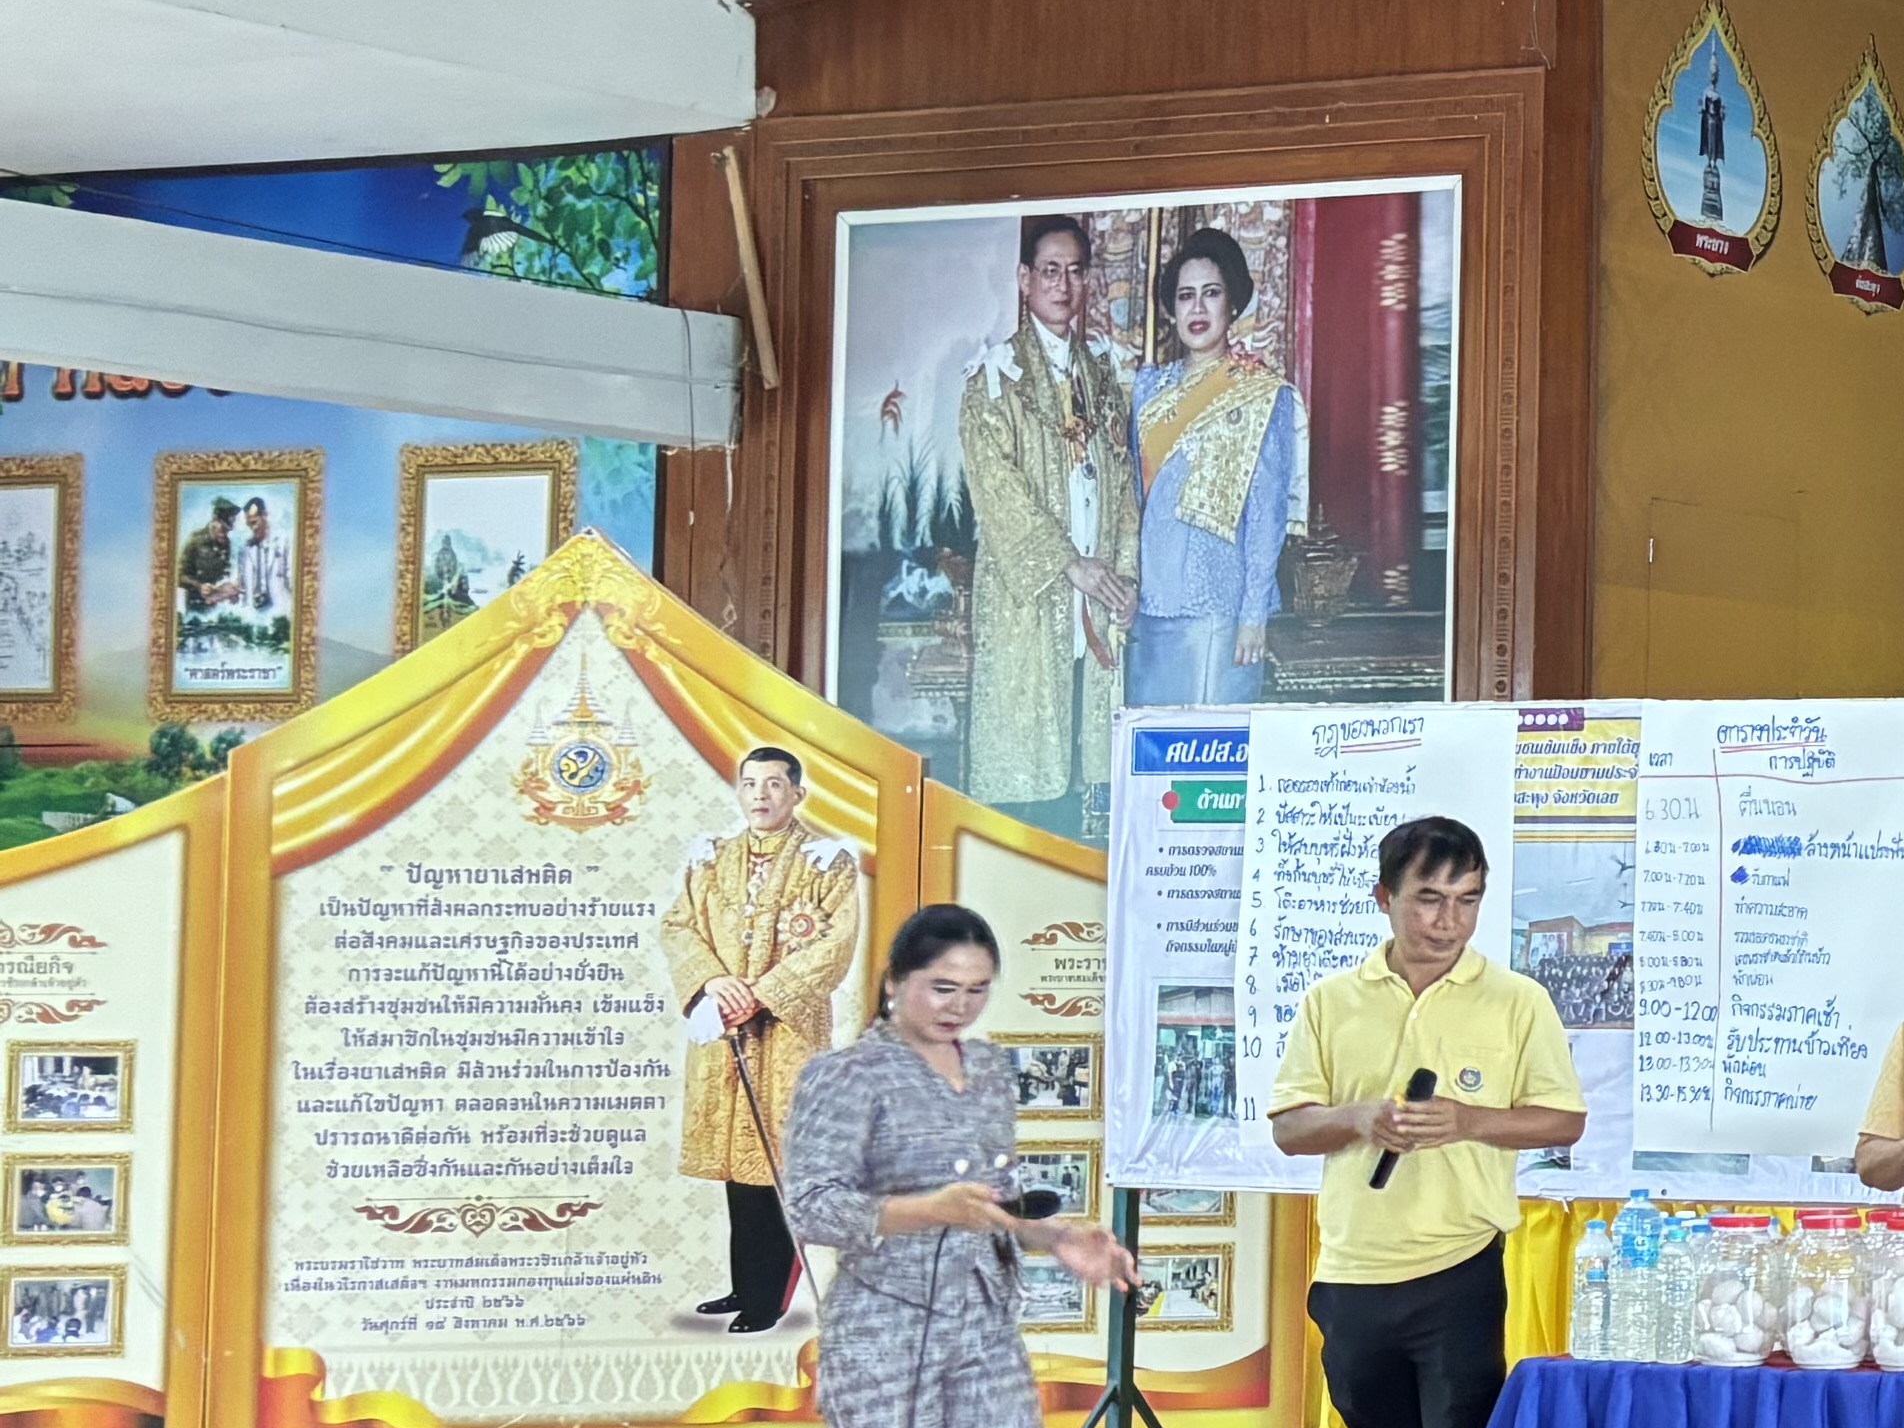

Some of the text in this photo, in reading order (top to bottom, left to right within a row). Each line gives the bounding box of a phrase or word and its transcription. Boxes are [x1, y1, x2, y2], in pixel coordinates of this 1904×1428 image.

[1255, 837, 1265, 853] 3
[1189, 864, 1217, 877] 100%
[1252, 868, 1261, 881] 4
[1249, 918, 1257, 936] 6
[1248, 946, 1258, 966] 7
[1244, 1097, 1256, 1121] 11
